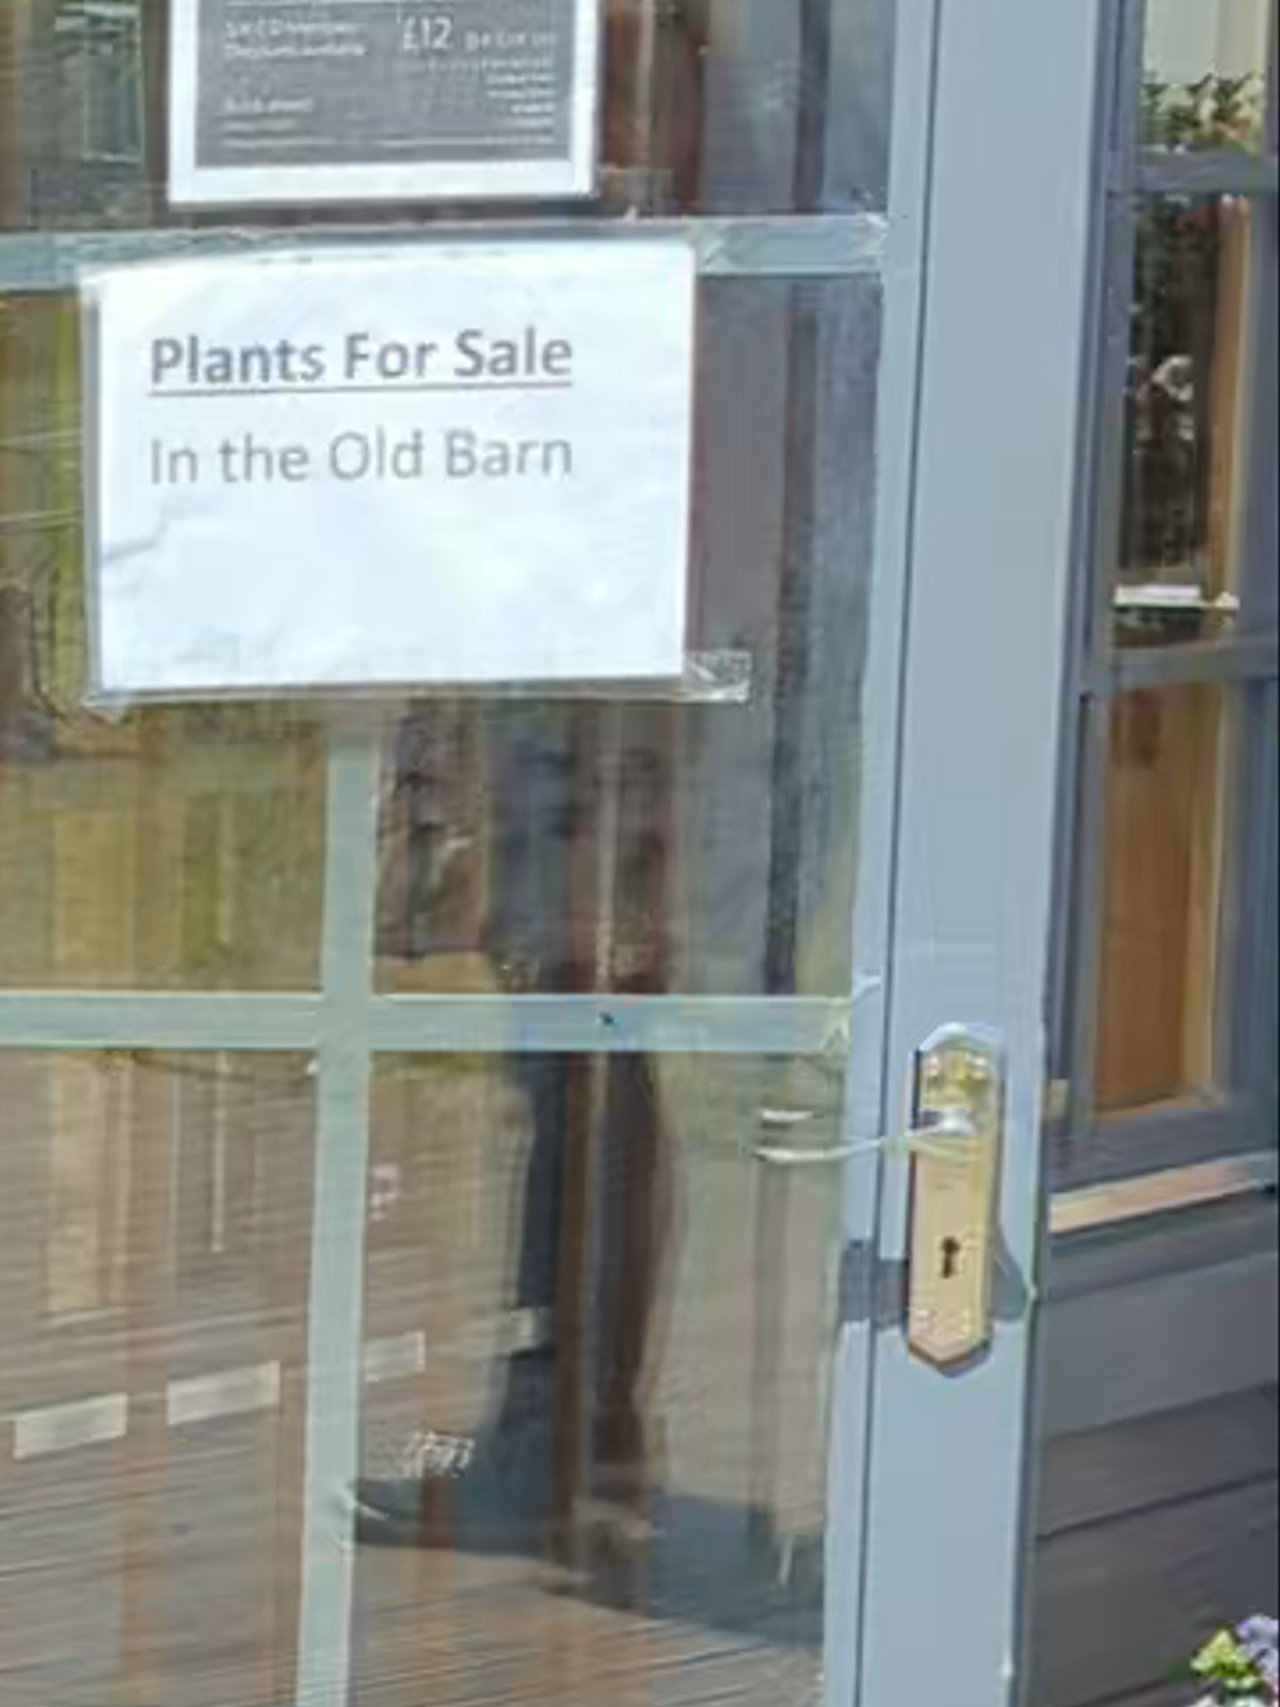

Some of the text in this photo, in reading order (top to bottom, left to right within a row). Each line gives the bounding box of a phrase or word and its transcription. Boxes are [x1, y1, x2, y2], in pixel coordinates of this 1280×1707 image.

[149, 326, 573, 385] Plants For Sale
[150, 429, 573, 485] In the Old Barn
